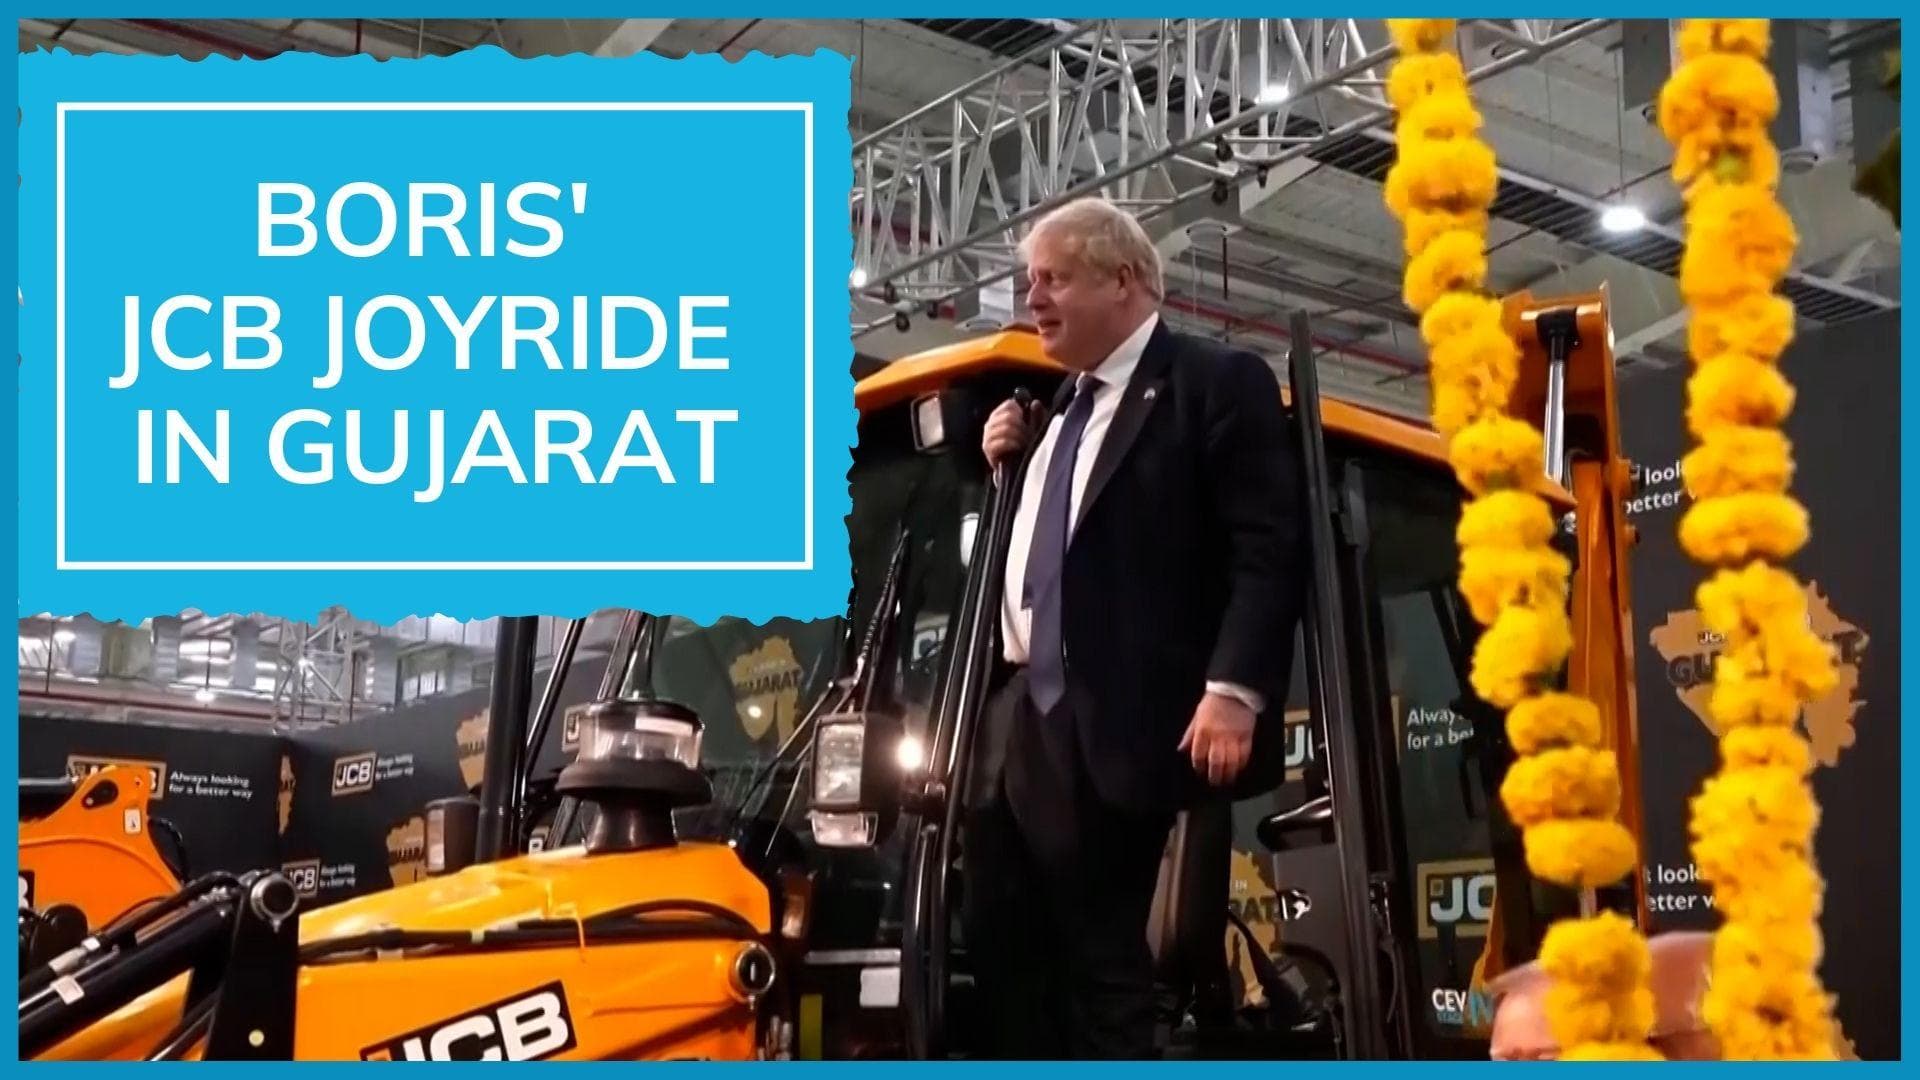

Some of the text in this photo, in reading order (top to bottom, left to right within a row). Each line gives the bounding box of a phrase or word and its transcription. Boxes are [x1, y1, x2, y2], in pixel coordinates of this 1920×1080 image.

[1407, 706, 1464, 727] Alway
[1407, 731, 1430, 750] for
[1434, 733, 1444, 746] a
[335, 760, 372, 788] JCB
[289, 868, 316, 890] CB
[1430, 875, 1497, 921] JC
[1647, 894, 1698, 912] etter
[1432, 987, 1467, 1012] CEV
